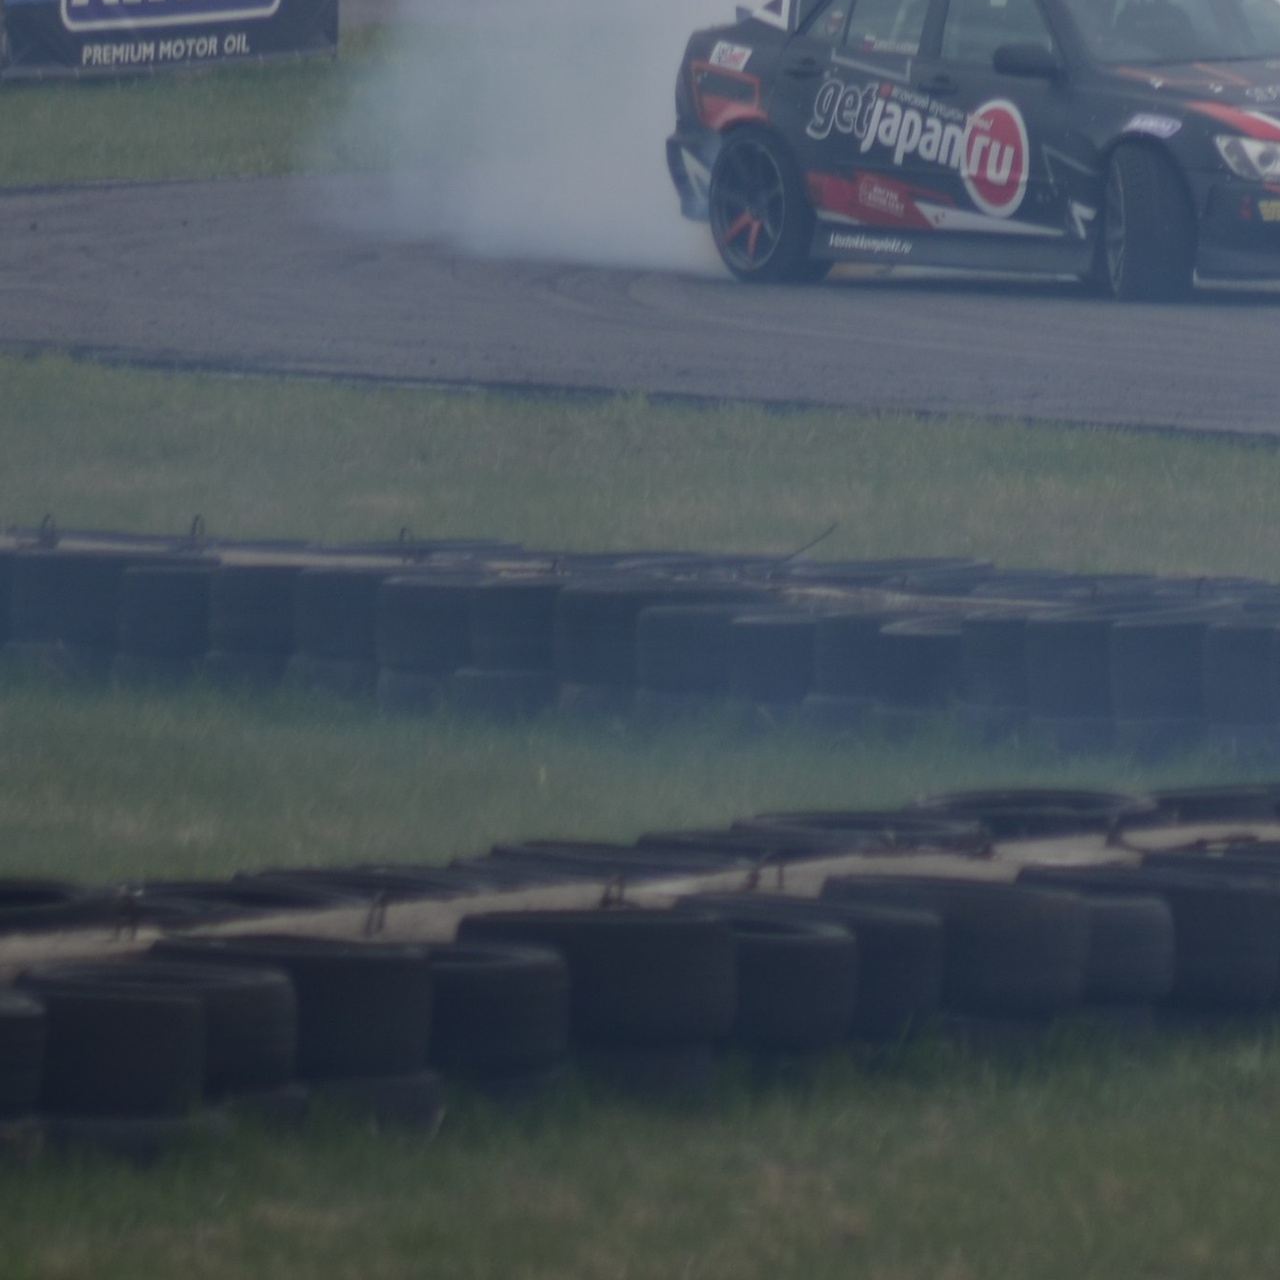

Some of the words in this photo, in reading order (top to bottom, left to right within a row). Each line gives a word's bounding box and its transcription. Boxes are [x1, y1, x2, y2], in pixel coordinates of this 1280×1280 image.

[82, 40, 155, 65] PREMIUM
[159, 36, 218, 60] MOTOR
[224, 33, 250, 53] OIL
